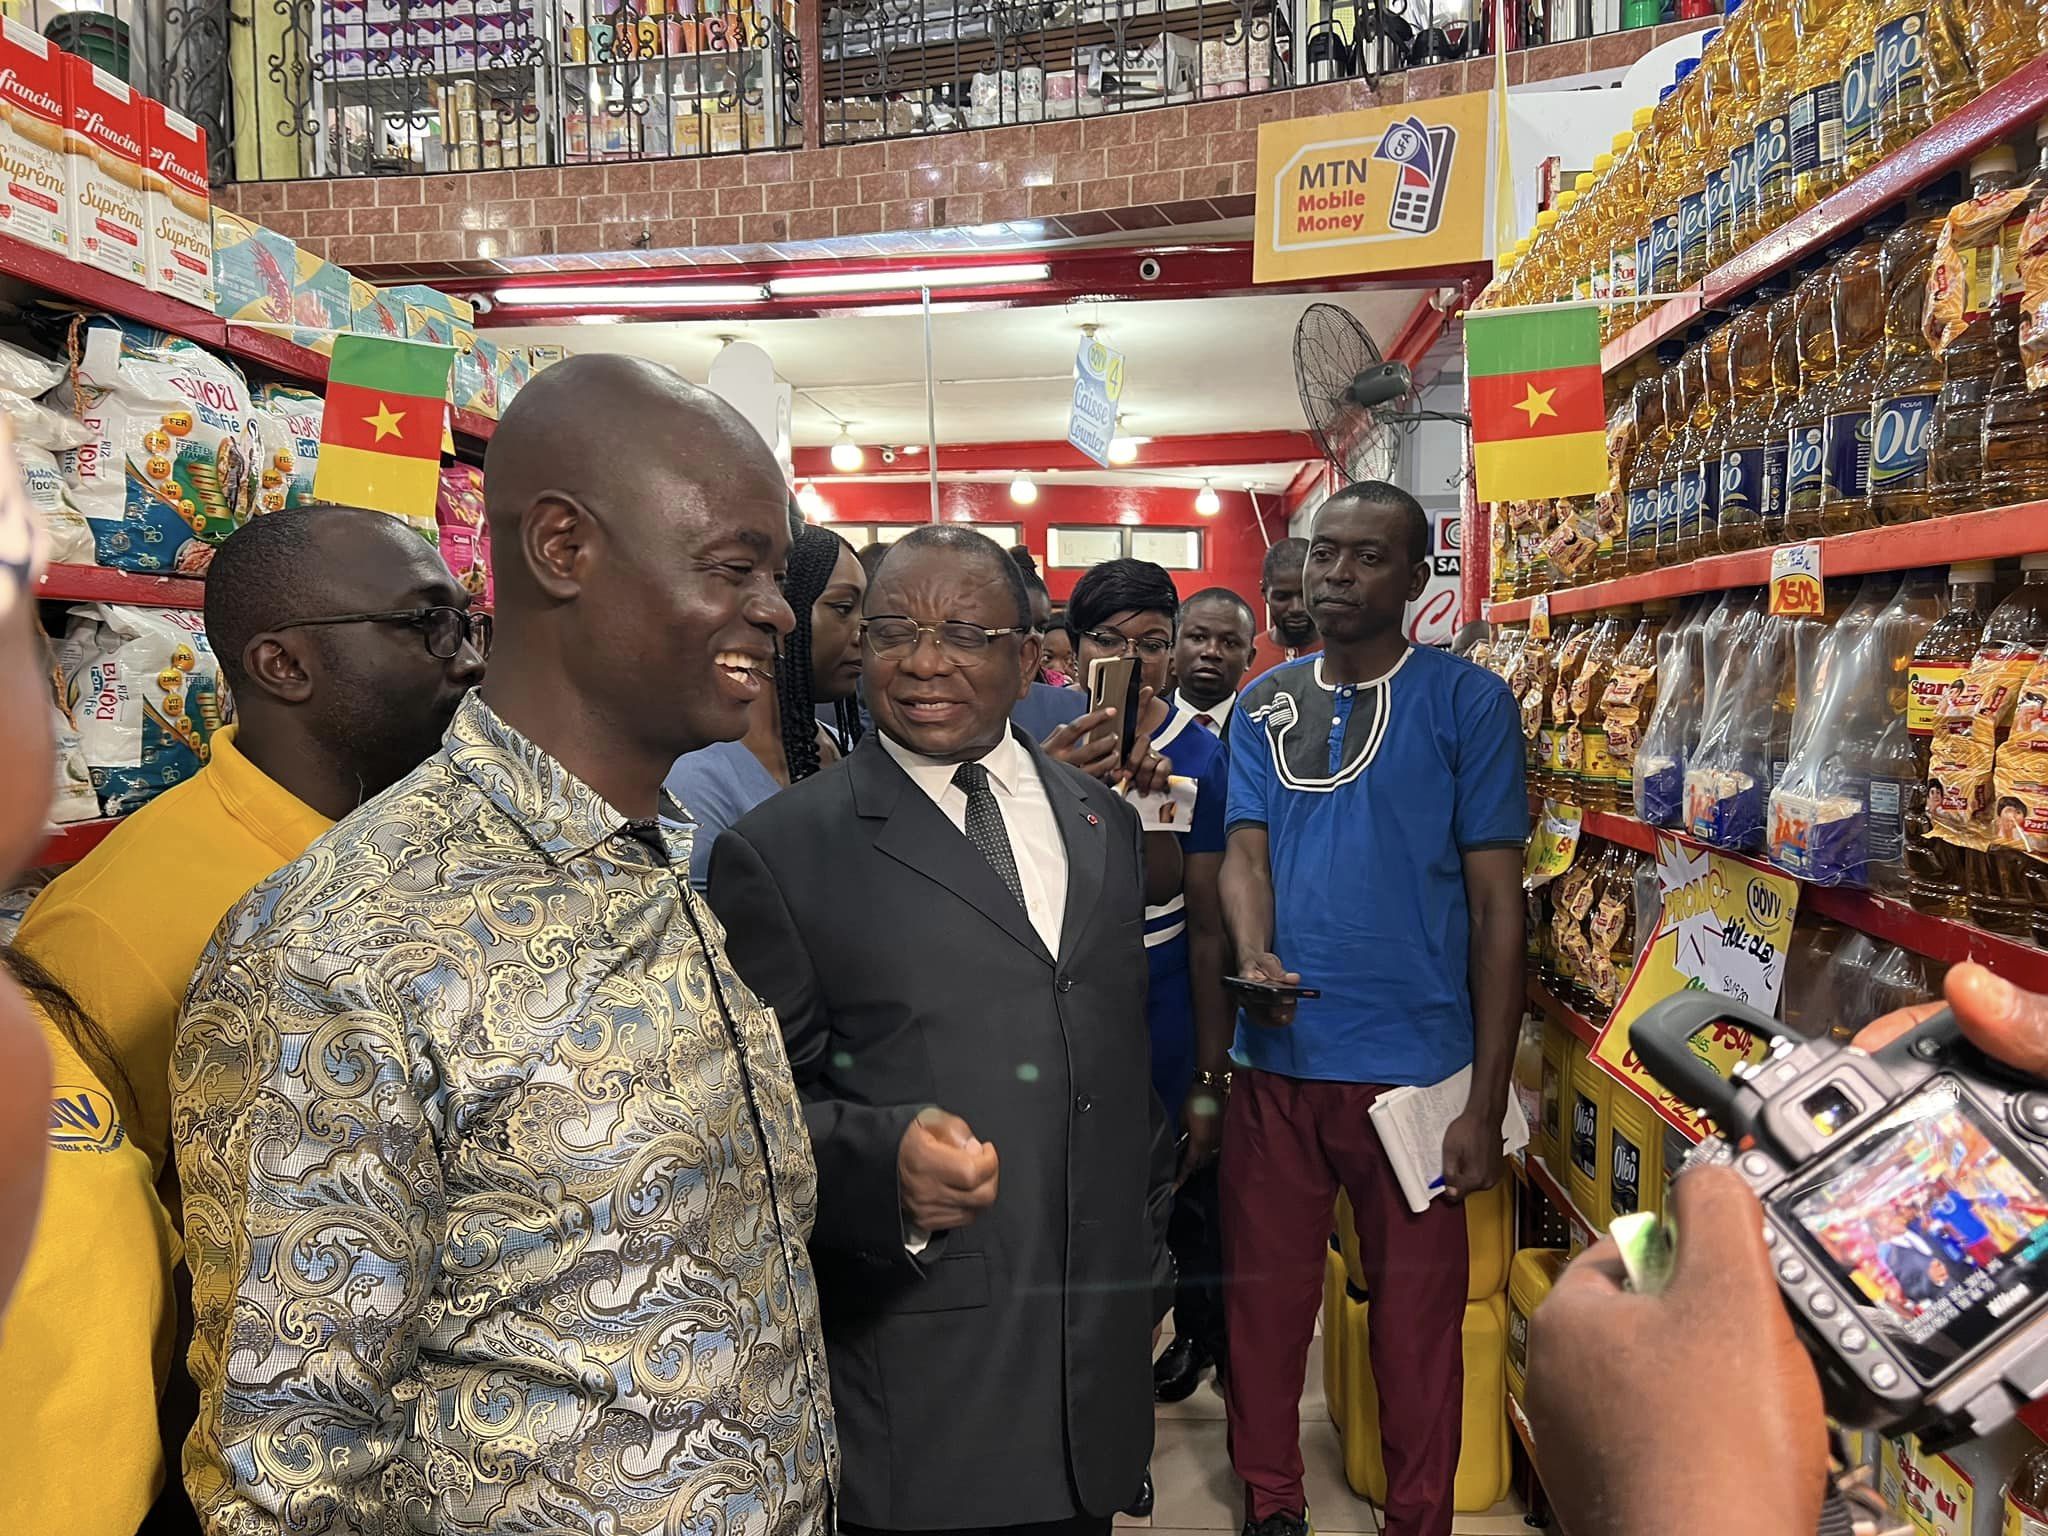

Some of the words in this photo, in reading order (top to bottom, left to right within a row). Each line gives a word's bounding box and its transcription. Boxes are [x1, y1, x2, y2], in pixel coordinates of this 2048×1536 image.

[0, 69, 63, 117] francine
[84, 113, 142, 157] francine
[1393, 132, 1413, 157] CFA
[158, 151, 210, 190] francine
[1299, 158, 1368, 191] MTN
[79, 182, 144, 230] Suprême
[1297, 189, 1366, 214] Mobile
[1297, 212, 1365, 234] Money
[1111, 363, 1120, 394] 4
[1074, 378, 1110, 426] Caisse
[1070, 414, 1105, 453] Counter
[1614, 1145, 1637, 1183] Oléo
